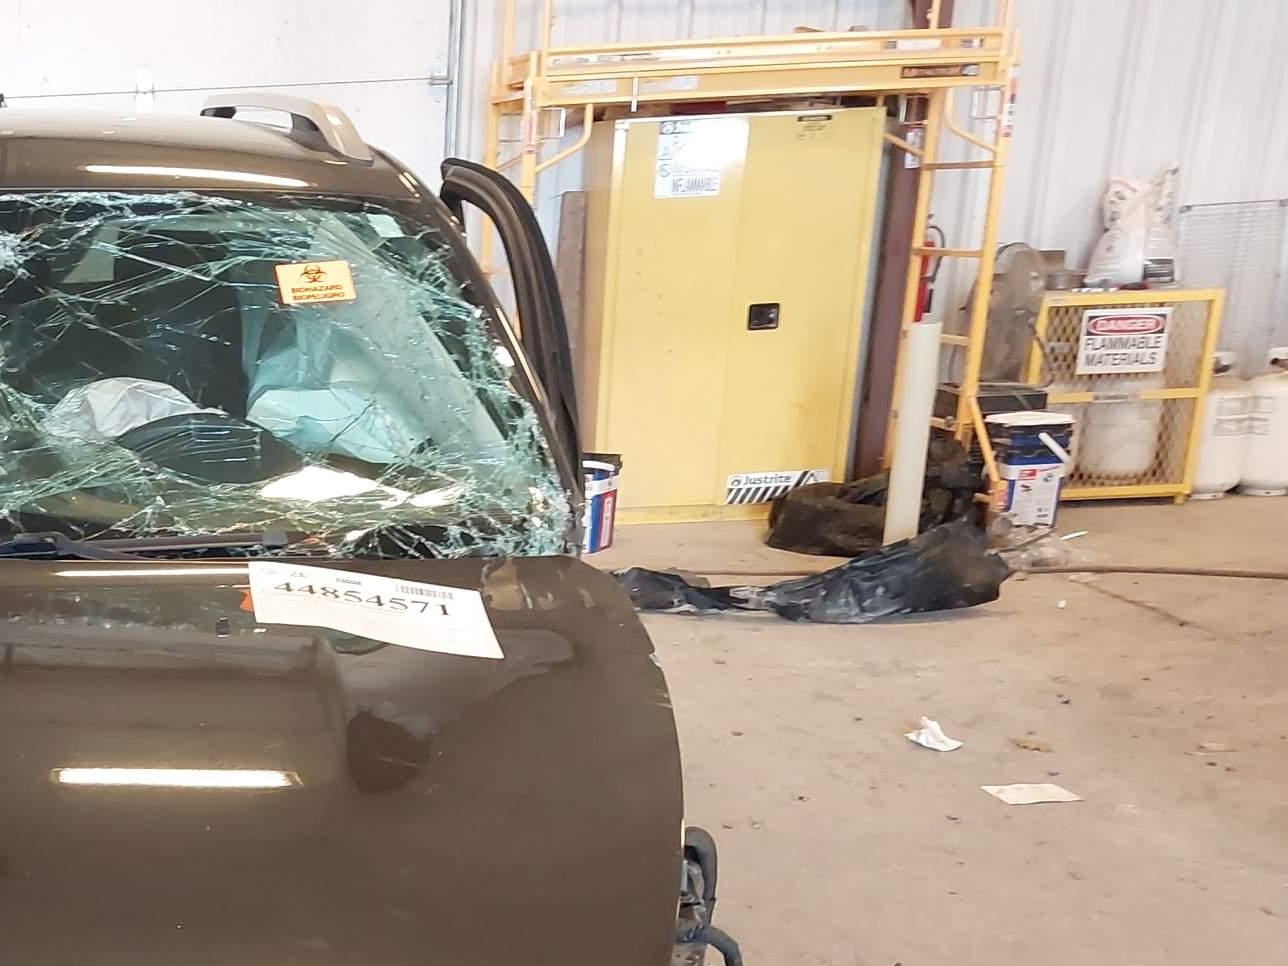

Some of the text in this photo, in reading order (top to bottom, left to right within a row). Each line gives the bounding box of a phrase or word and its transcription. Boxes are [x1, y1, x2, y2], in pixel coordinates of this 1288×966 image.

[291, 284, 343, 294] BIOHAZARD
[1095, 318, 1157, 331] DANGER
[1084, 335, 1162, 350] FLAMMABLE
[1084, 351, 1158, 367] MATERIALS
[743, 473, 792, 485] Justrite
[274, 582, 451, 616] 44854571
